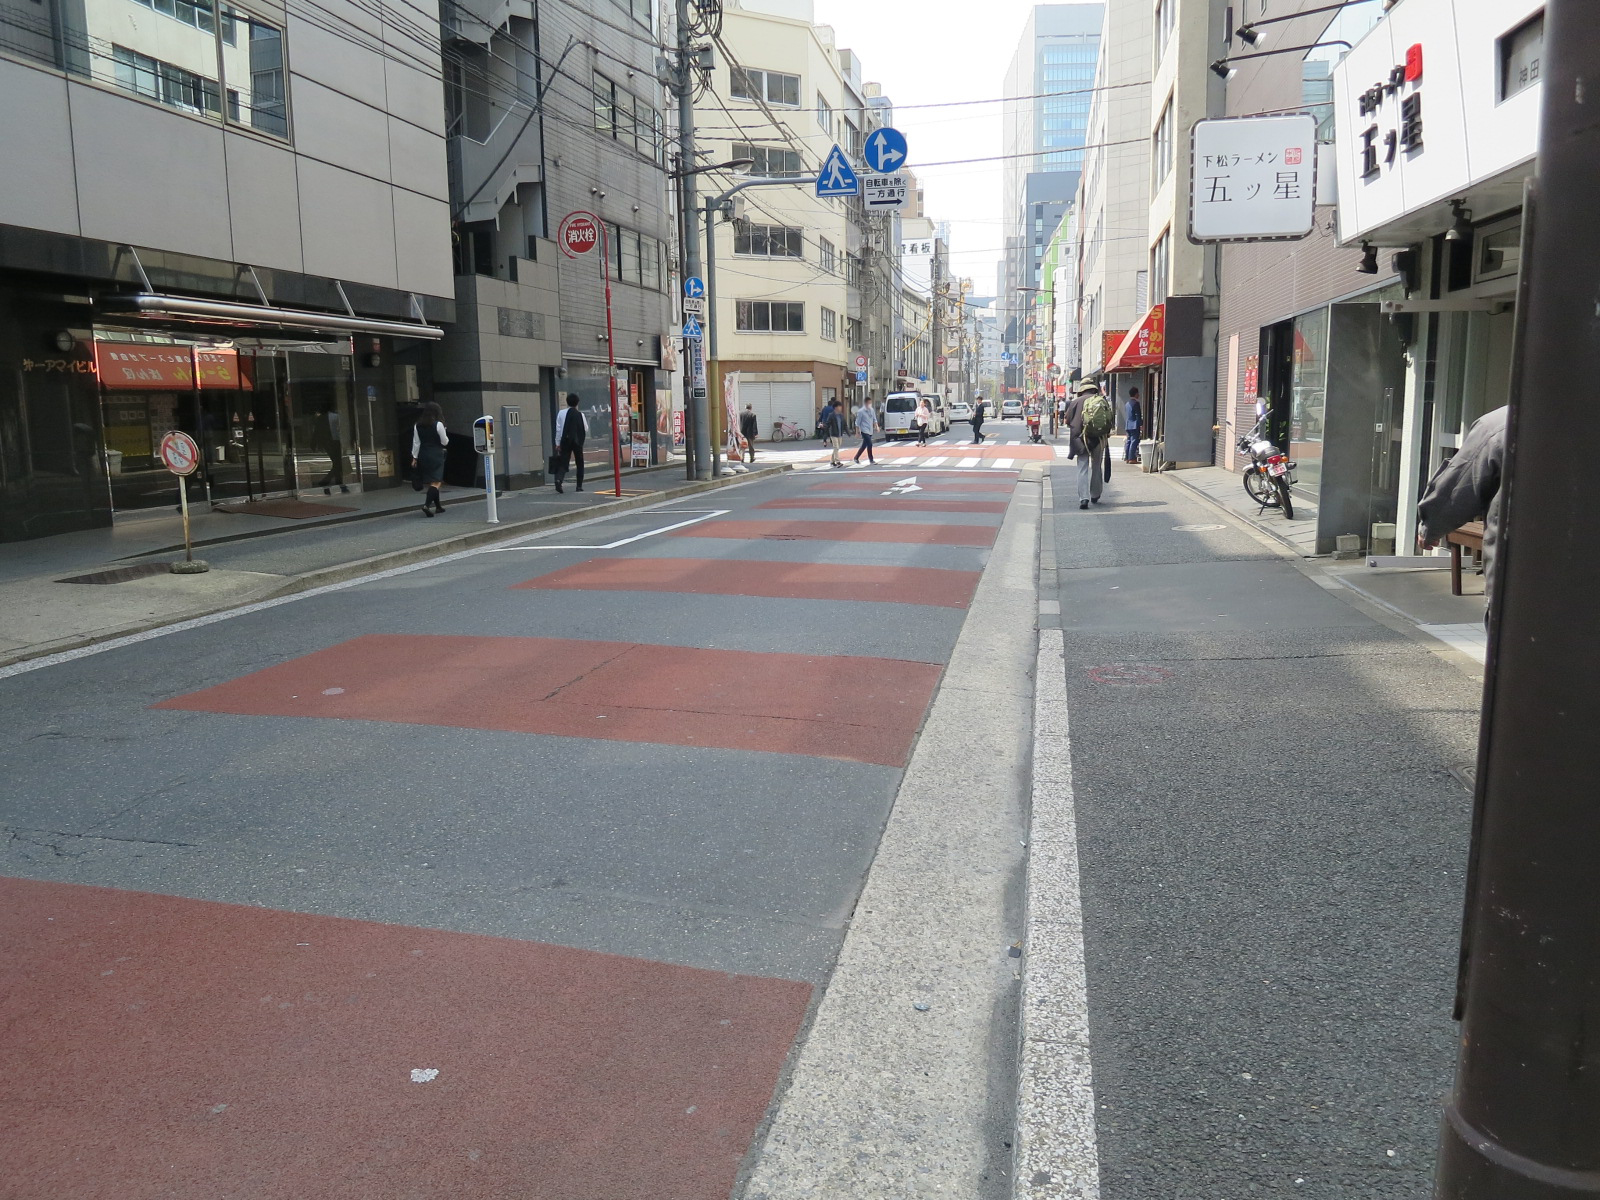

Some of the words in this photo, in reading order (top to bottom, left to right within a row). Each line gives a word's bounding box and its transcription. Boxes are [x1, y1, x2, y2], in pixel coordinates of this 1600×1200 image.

[1519, 58, 1540, 88] 神田
[1202, 152, 1278, 168] 下松ラーメン
[866, 177, 906, 188] 自転車を除く
[867, 189, 906, 198] 一方通行
[567, 228, 595, 243] 消火栓
[1149, 308, 1163, 354] らーめん
